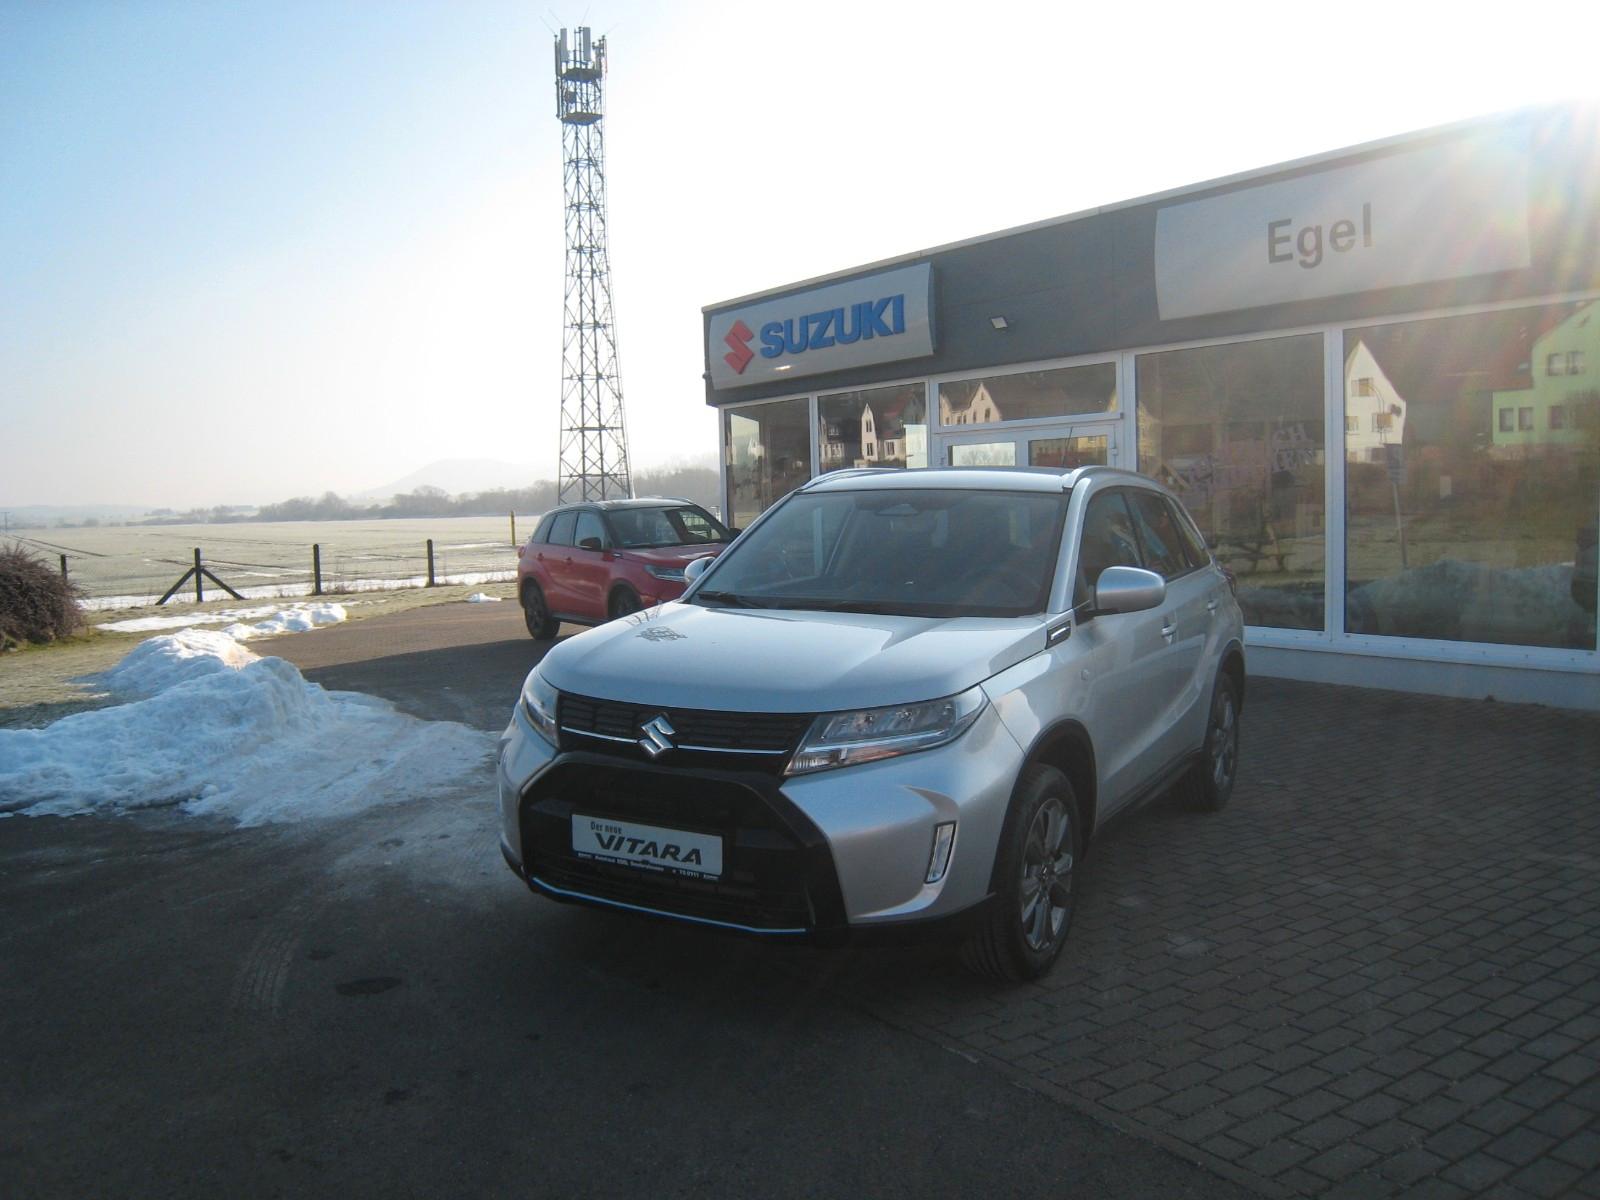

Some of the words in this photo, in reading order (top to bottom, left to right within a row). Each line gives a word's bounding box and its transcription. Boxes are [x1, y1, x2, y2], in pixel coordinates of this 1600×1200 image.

[1267, 202, 1373, 269] Egel
[759, 293, 906, 359] SUZUKI
[590, 820, 603, 832] Der
[605, 824, 622, 835] neue
[595, 832, 702, 865] VITARA
